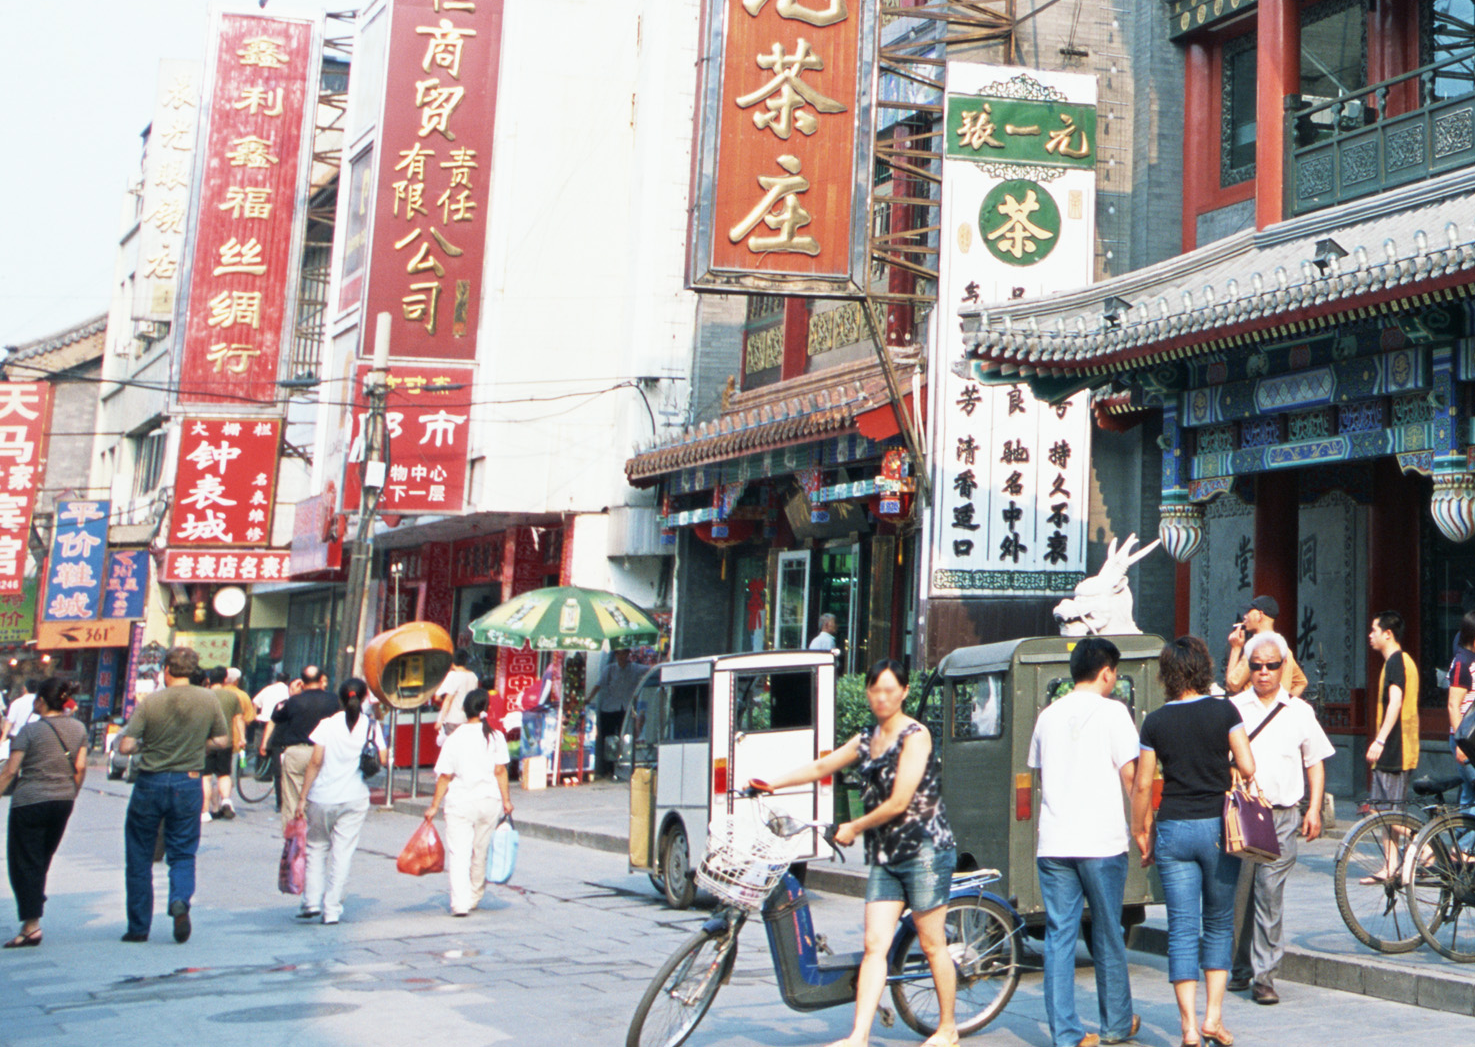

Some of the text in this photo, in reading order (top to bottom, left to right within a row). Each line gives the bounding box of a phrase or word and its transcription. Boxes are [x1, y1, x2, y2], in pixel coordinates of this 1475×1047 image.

[206, 35, 290, 374] 鑫利鑫福丝绸行
[987, 188, 1054, 259] 茶
[190, 420, 273, 437] 大栅栏
[176, 439, 242, 543] 钟表城
[245, 472, 268, 542] 名表维修
[379, 484, 446, 503] 下一层
[48, 502, 105, 618] 平价鞋城
